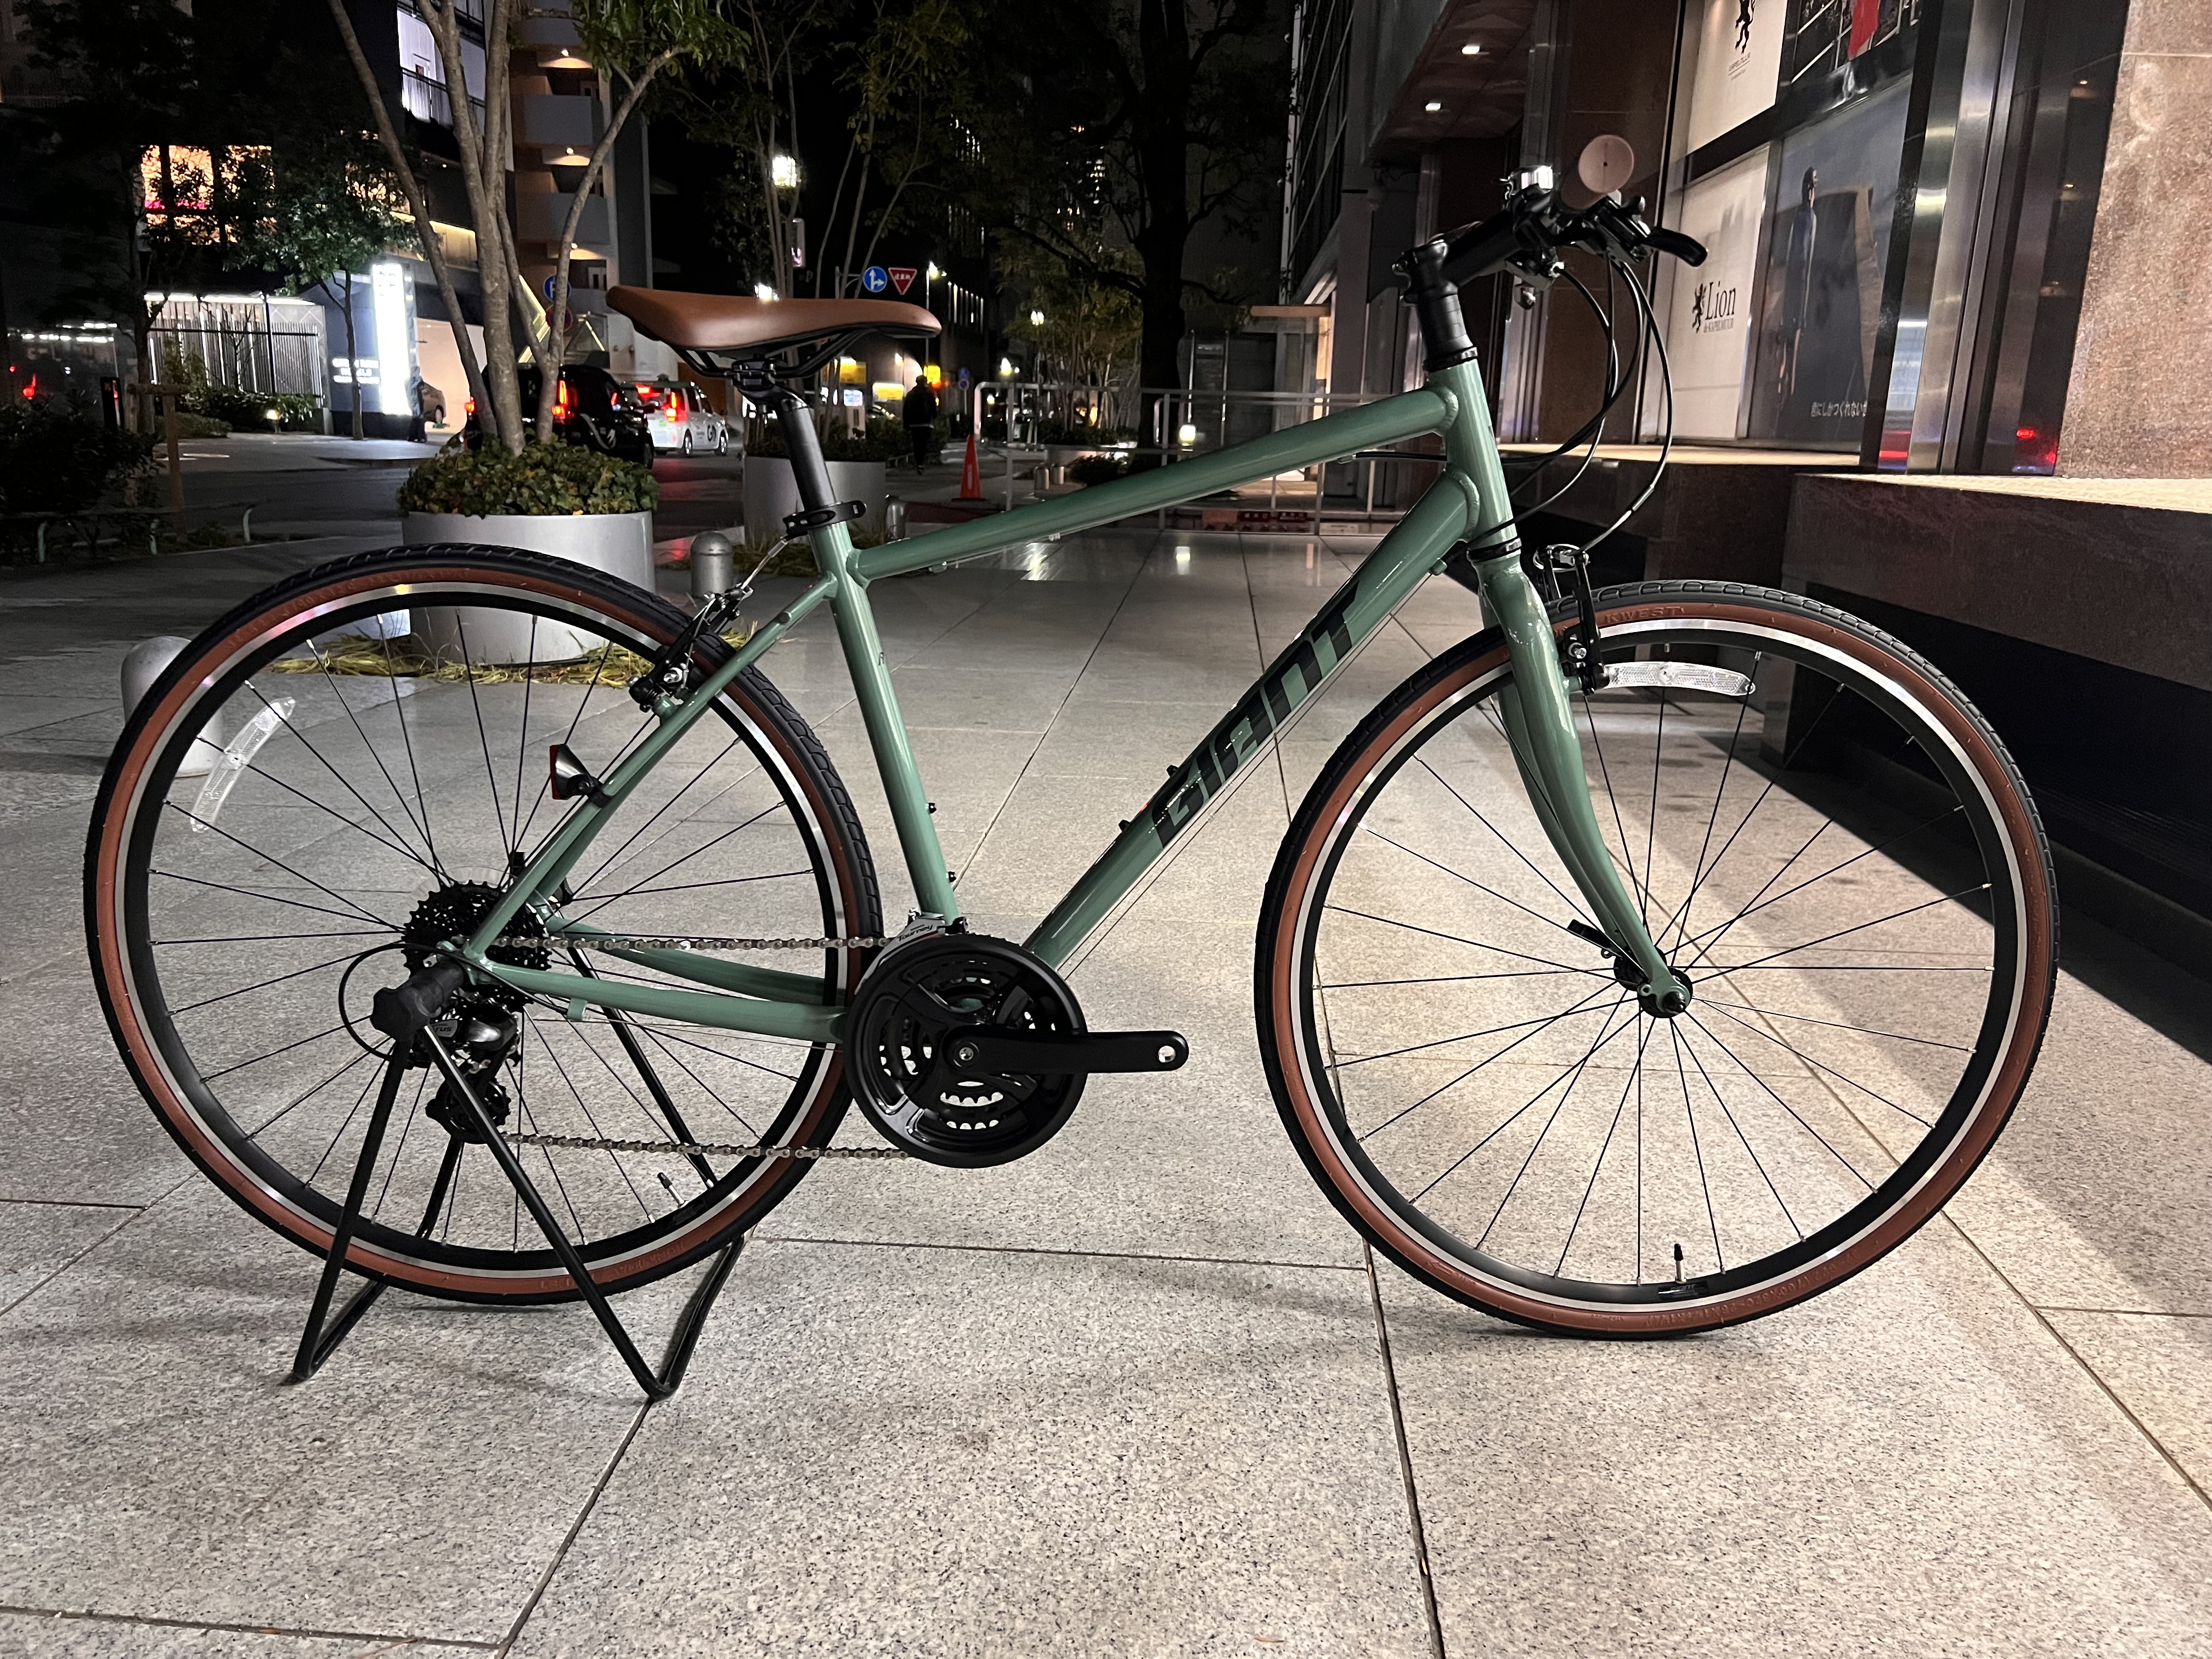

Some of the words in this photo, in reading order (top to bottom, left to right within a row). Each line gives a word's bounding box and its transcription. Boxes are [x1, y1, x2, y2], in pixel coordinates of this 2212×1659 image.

[1705, 280, 1736, 320] Lion
[1604, 605, 1680, 624] KWEST
[896, 924, 934, 942] Tourney
